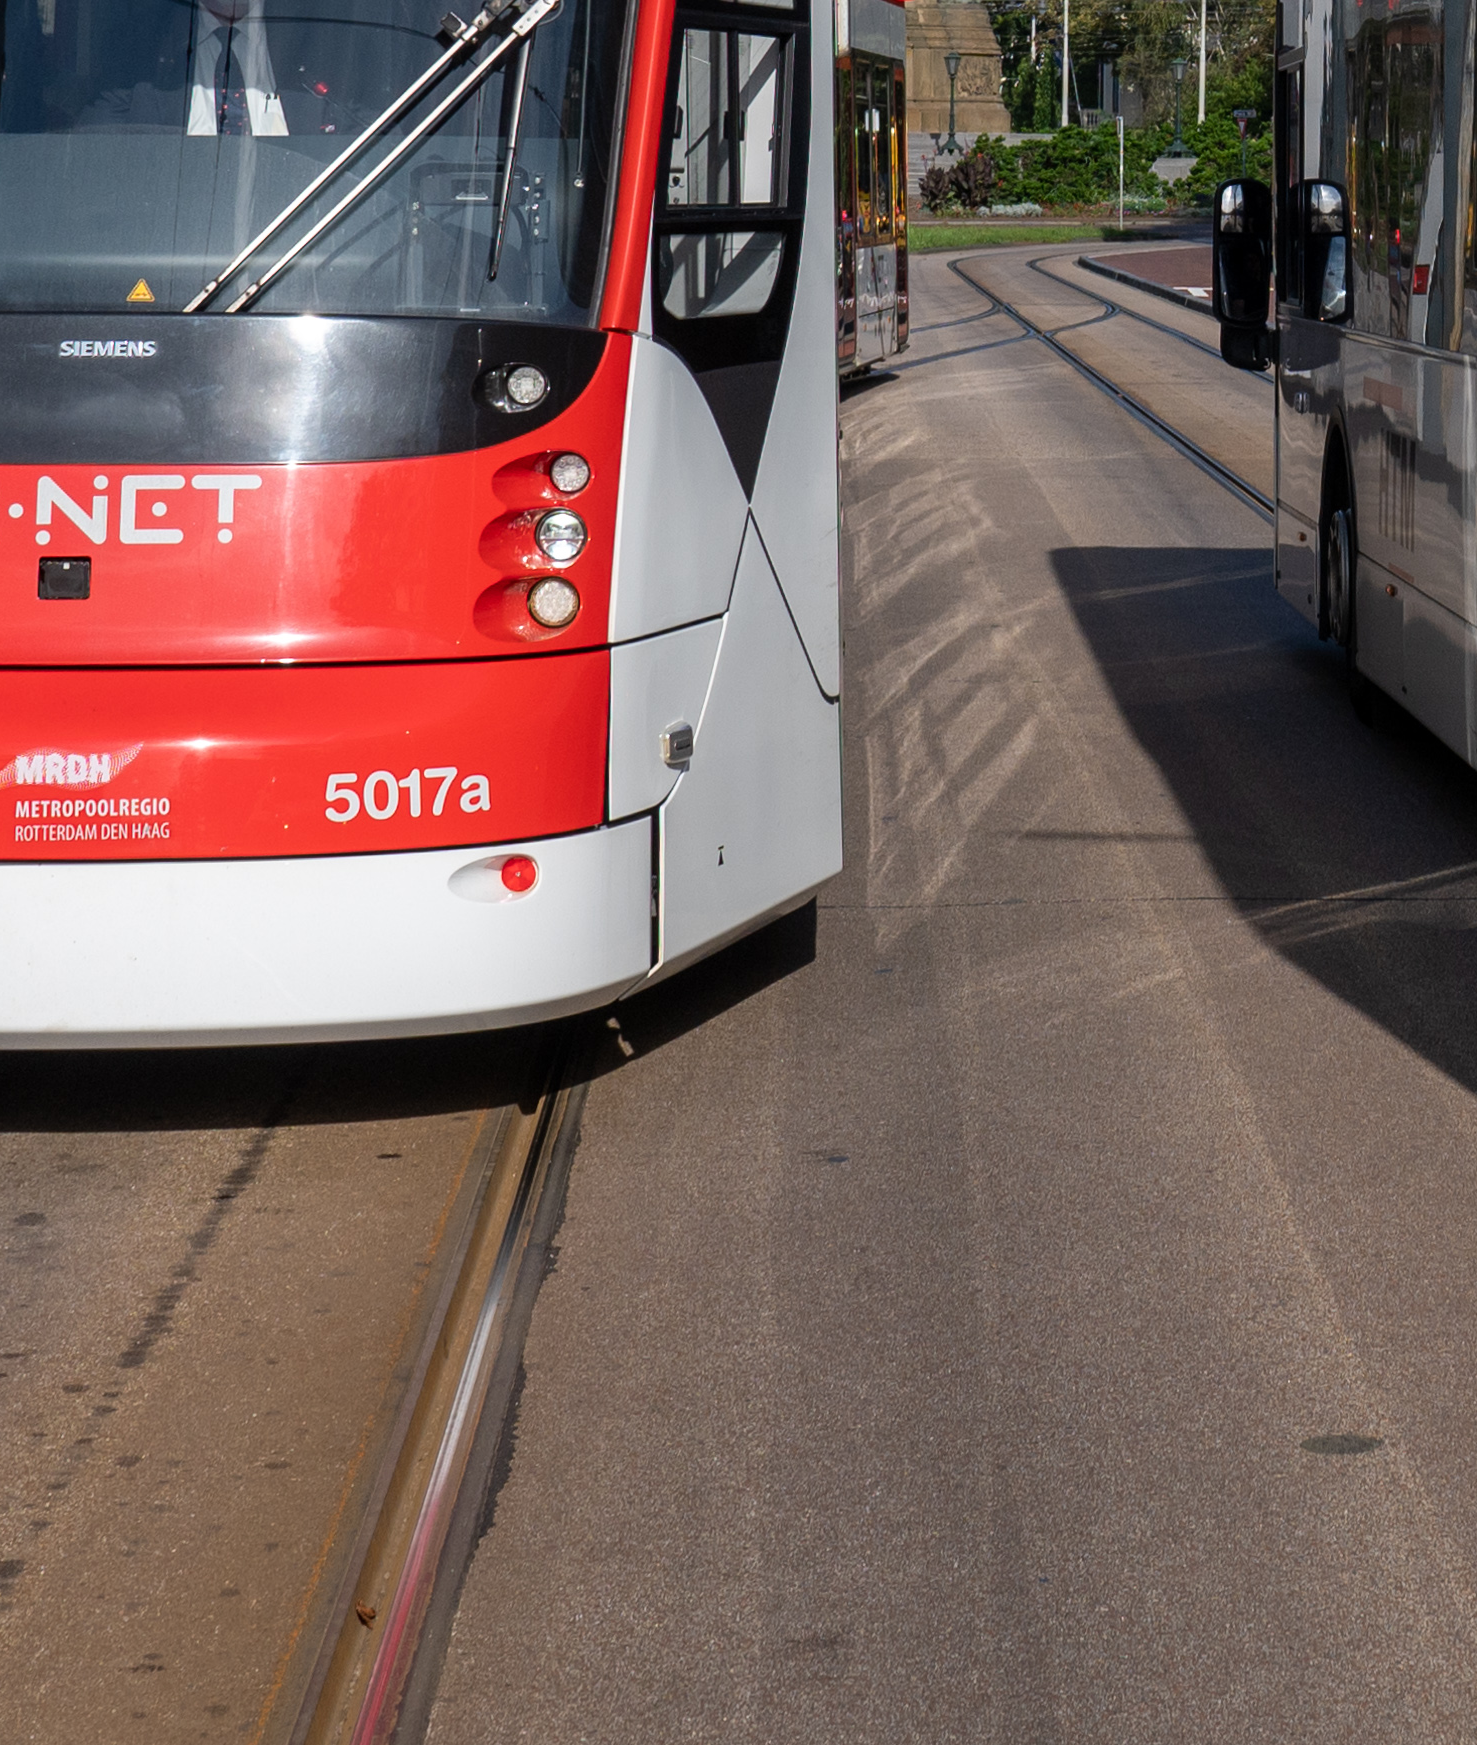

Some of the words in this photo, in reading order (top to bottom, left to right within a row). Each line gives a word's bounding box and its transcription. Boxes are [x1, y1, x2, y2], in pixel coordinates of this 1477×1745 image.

[59, 339, 156, 359] SIEMENS
[14, 753, 111, 785] MRDH
[325, 766, 492, 823] 5017a
[14, 797, 171, 819] METROPOOLREGIO
[14, 823, 97, 842] ROTTERDAM
[101, 823, 128, 841] DEN
[131, 822, 171, 840] HAAG
